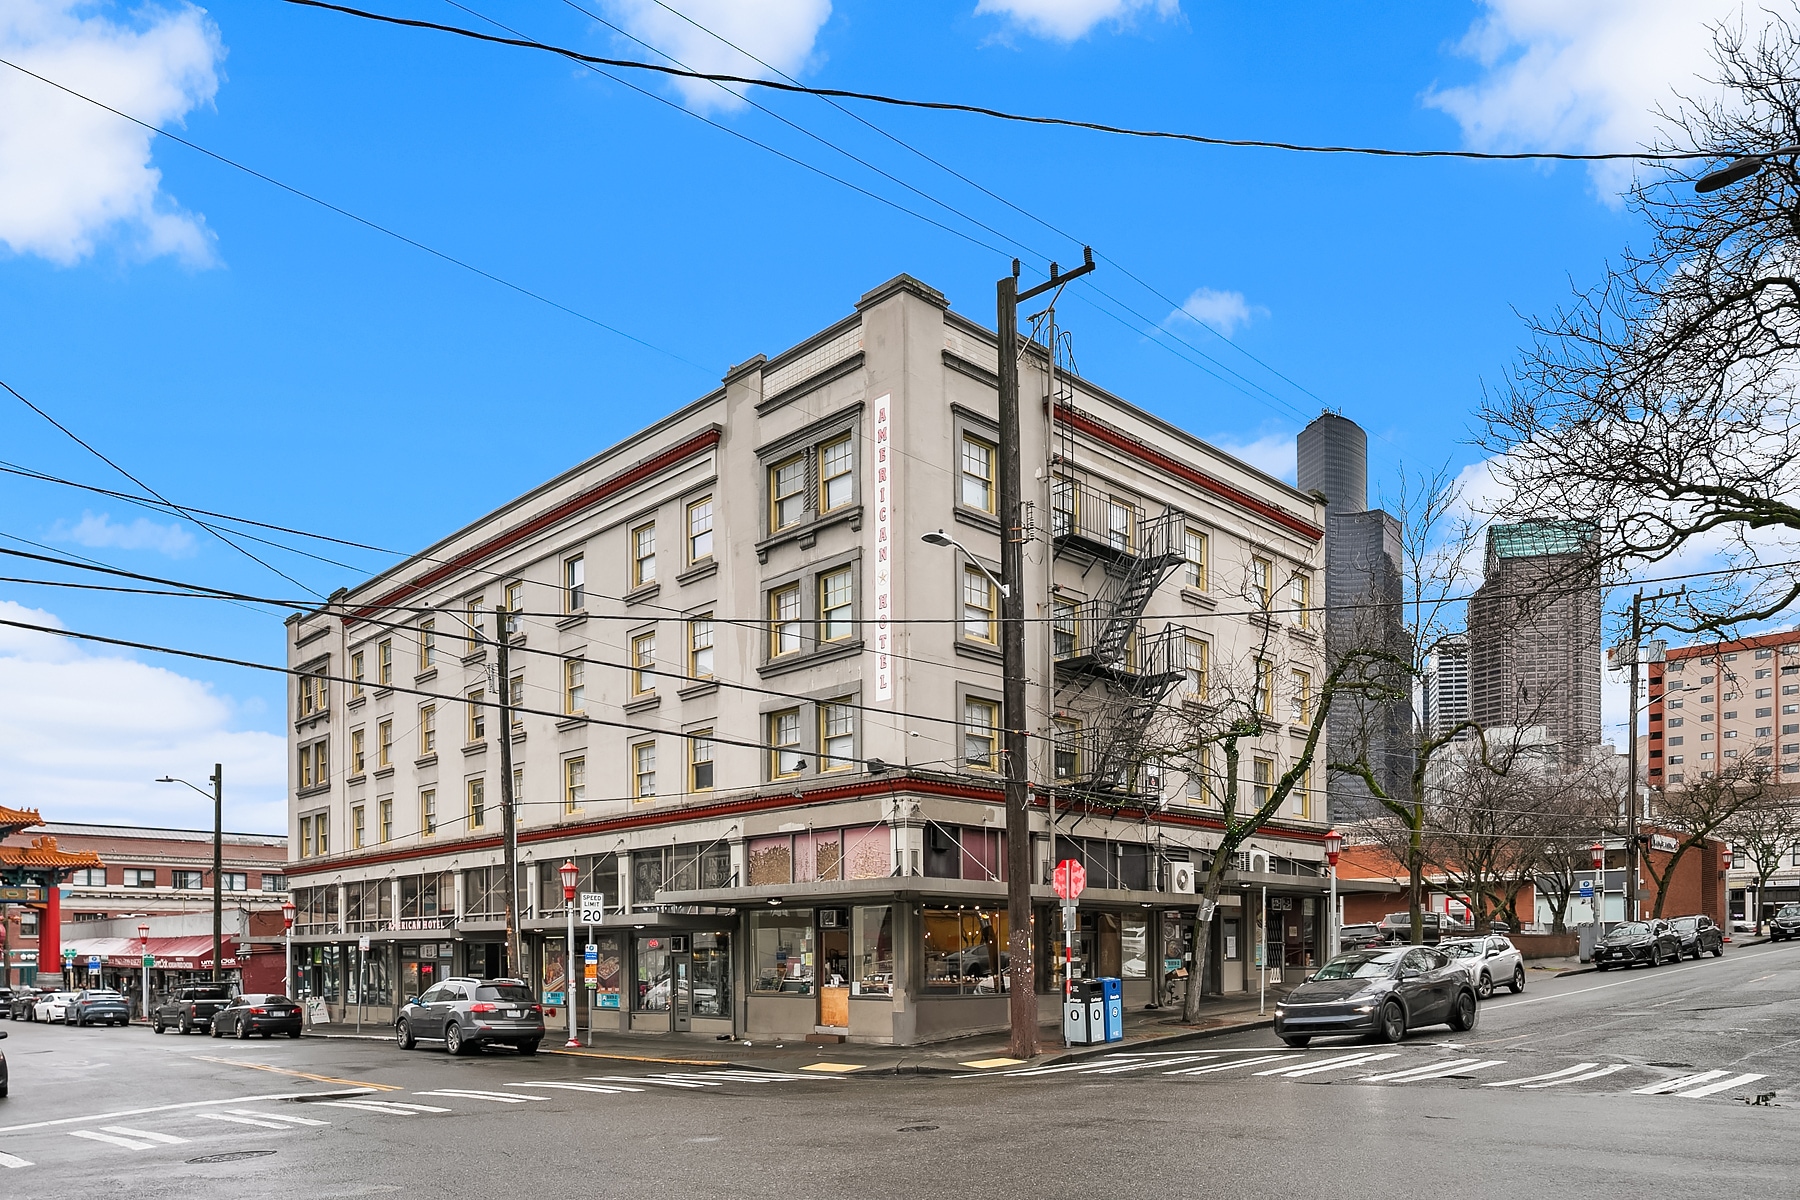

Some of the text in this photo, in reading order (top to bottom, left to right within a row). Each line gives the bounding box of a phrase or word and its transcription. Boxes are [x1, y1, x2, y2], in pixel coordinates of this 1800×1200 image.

[877, 407, 889, 690] AMERICAN HOTEL
[583, 909, 601, 922] 20
[423, 919, 445, 930] HOTEL
